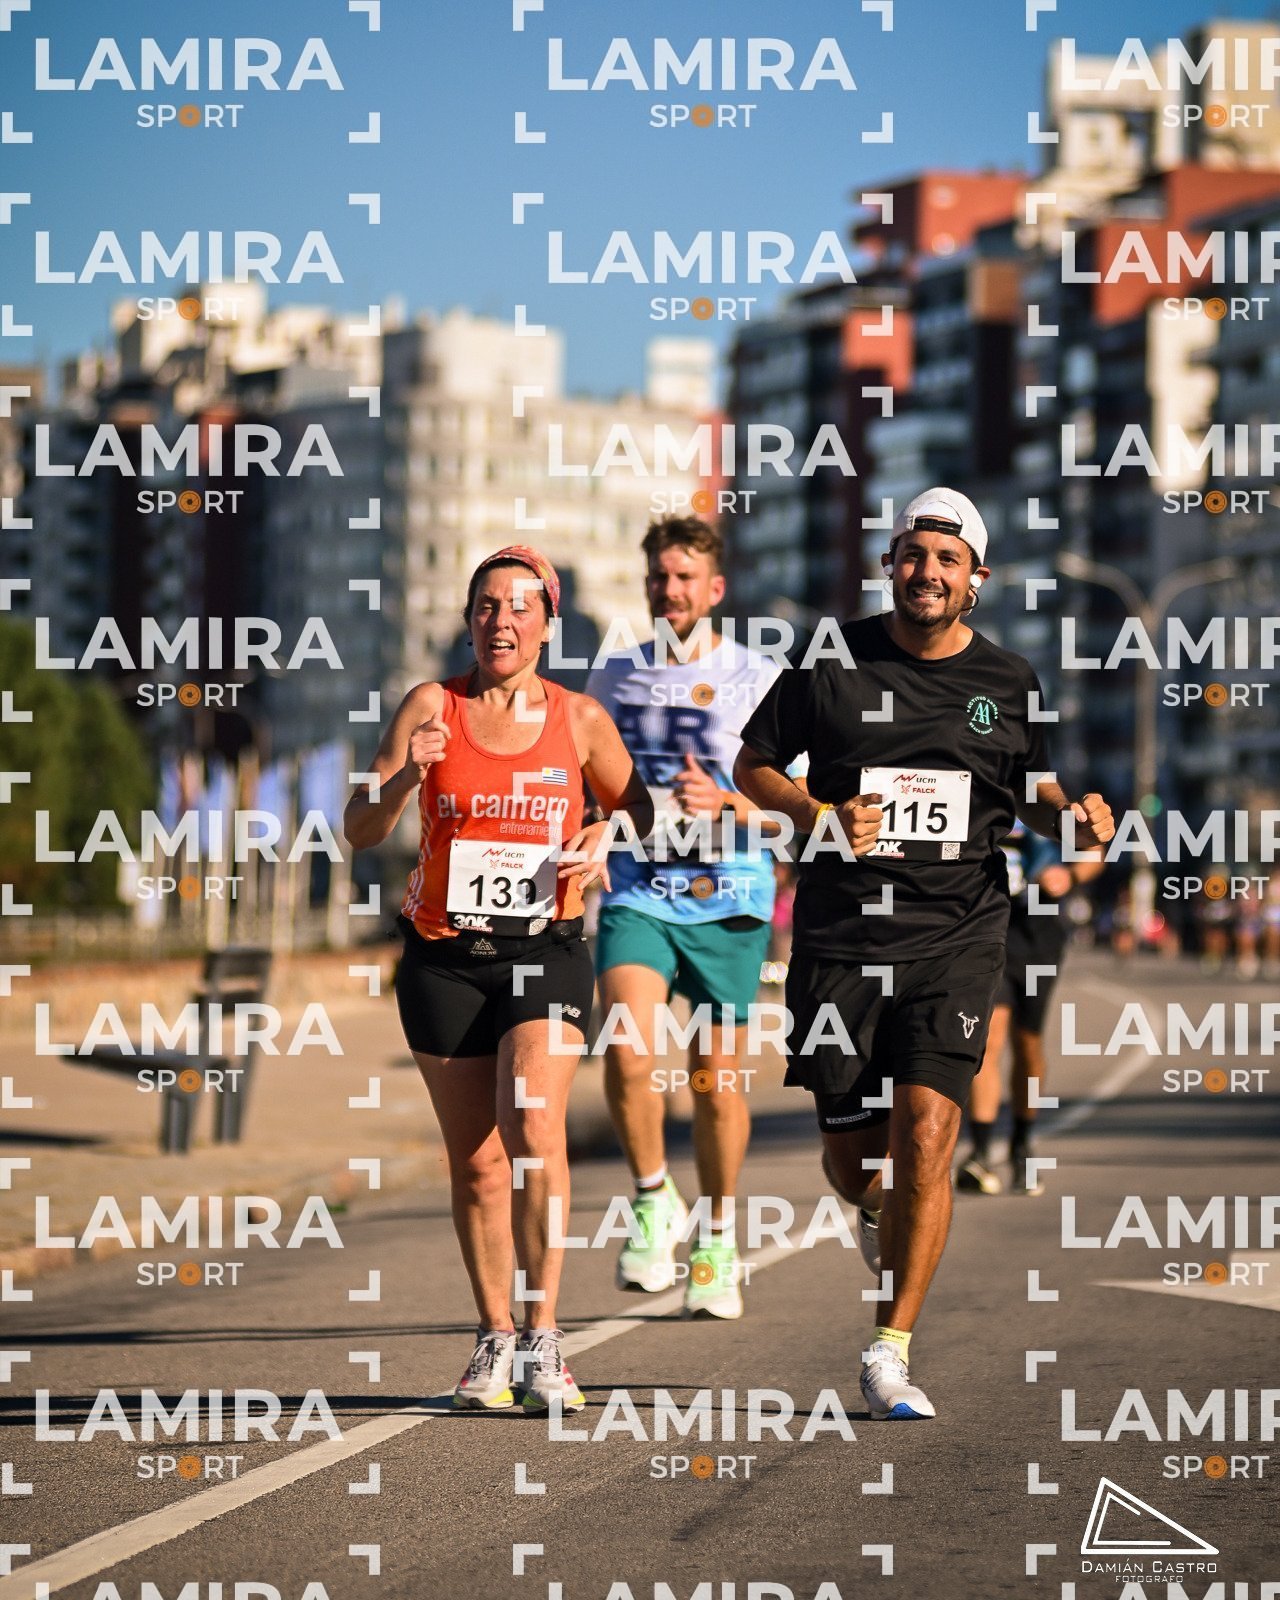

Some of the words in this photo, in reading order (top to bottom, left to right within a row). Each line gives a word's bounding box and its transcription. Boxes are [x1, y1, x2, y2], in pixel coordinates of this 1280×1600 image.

[916, 776, 937, 784] ucm
[881, 800, 948, 834] 115
[866, 840, 902, 856] 0K
[504, 851, 525, 859] ucm
[500, 862, 524, 870] FALCK
[453, 914, 491, 930] 30K
